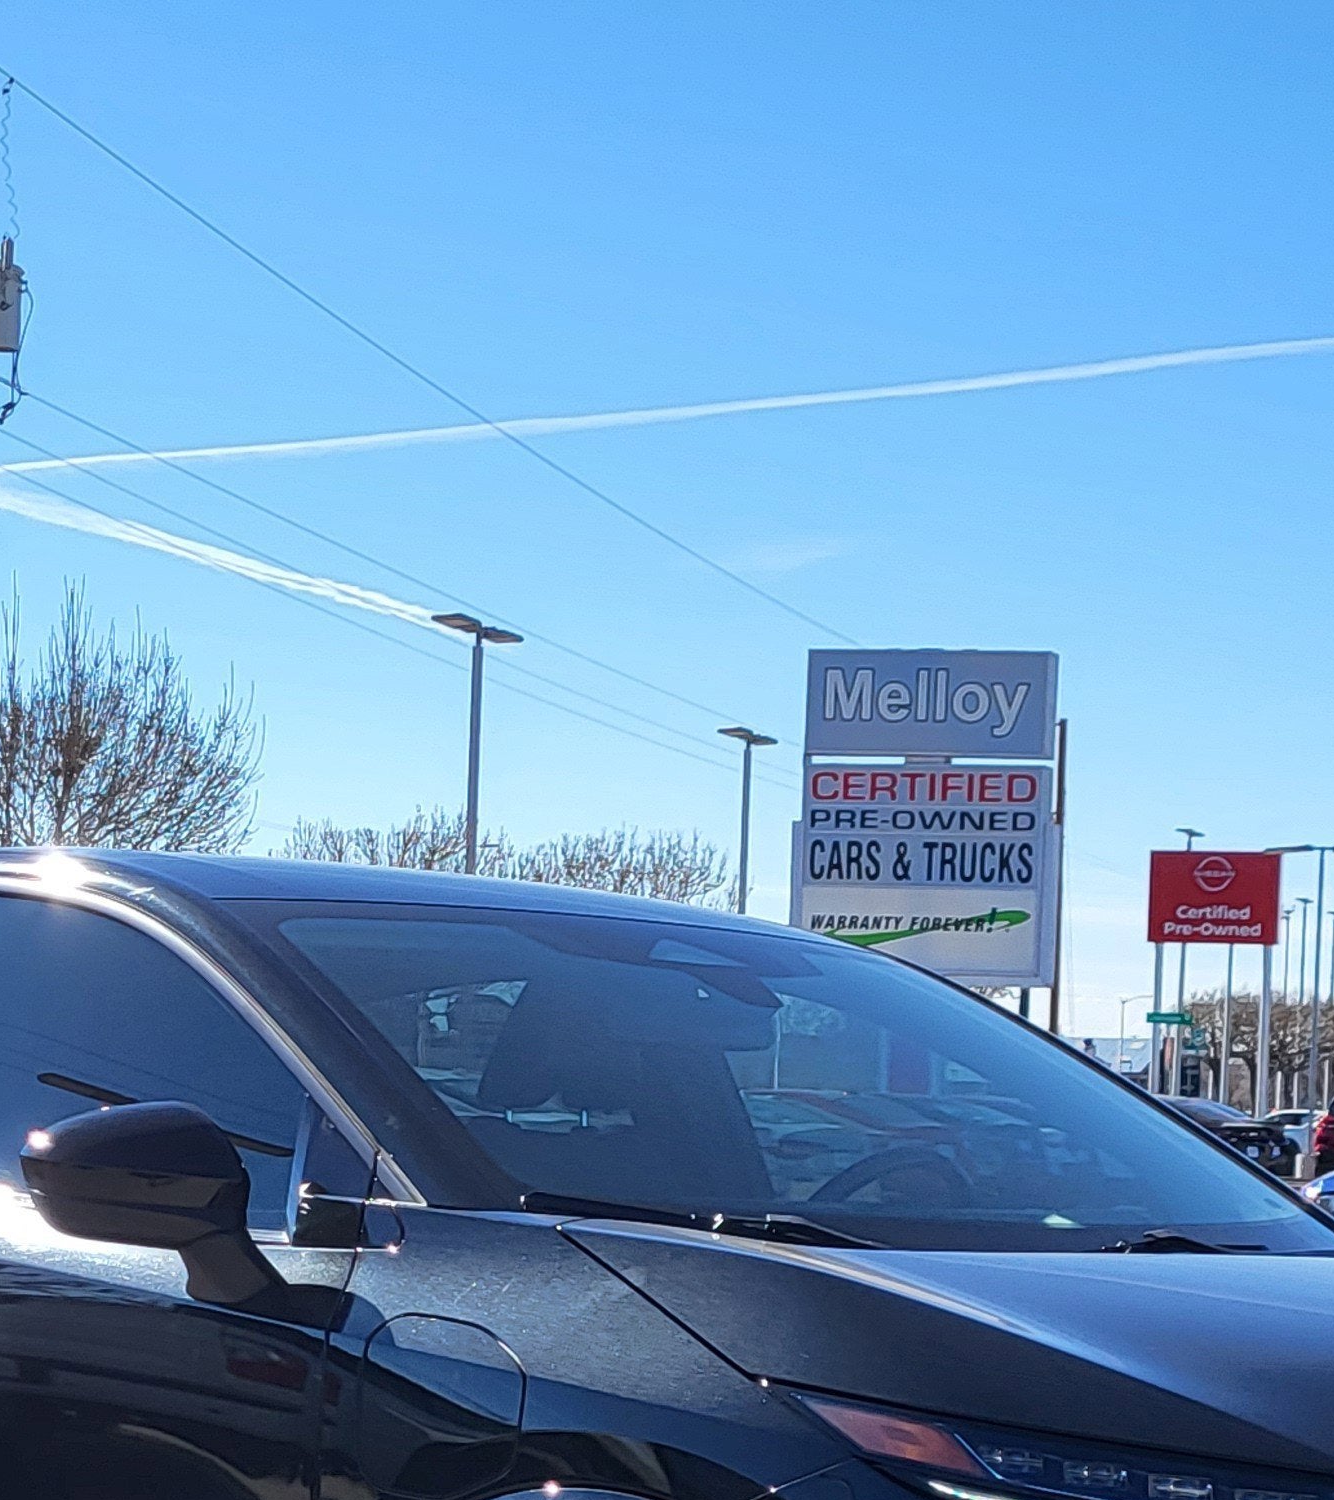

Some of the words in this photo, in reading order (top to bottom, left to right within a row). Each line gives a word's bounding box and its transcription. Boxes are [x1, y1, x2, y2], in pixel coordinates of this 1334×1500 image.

[822, 667, 1031, 738] Melloy
[811, 771, 1038, 803] CERTIFIED
[809, 808, 1037, 832] PRE-OWNED
[809, 838, 881, 881] CARS
[892, 841, 912, 882] &
[923, 841, 1034, 884] TRUCKS
[810, 914, 904, 931] WARRANTY
[1175, 905, 1252, 920] Certified
[1163, 921, 1263, 937] Pre-Owned
